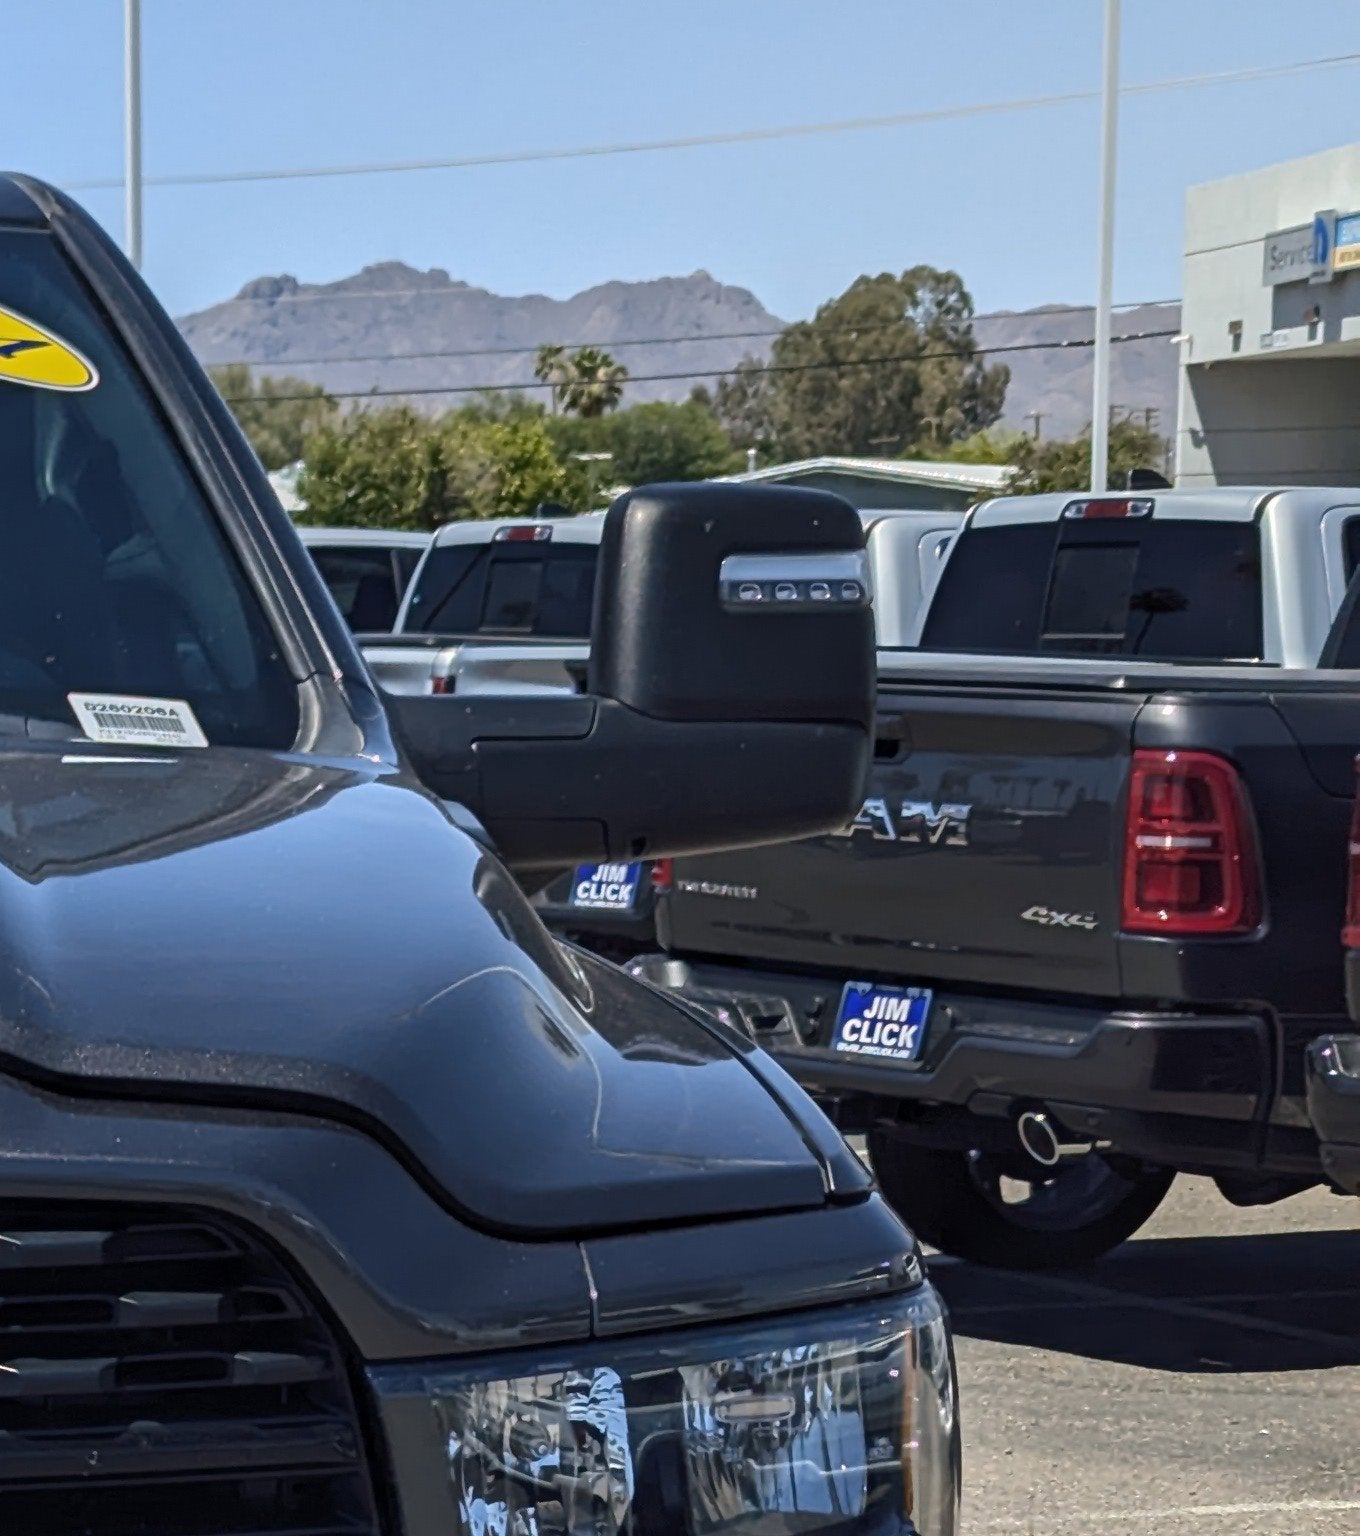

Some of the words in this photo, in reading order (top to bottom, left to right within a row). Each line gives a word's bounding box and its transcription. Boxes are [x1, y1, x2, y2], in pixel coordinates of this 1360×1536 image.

[830, 797, 973, 847] AM
[591, 864, 629, 883] JIM
[576, 880, 633, 901] CLICK
[862, 995, 912, 1023] JIM
[841, 1018, 919, 1049] CLICK
